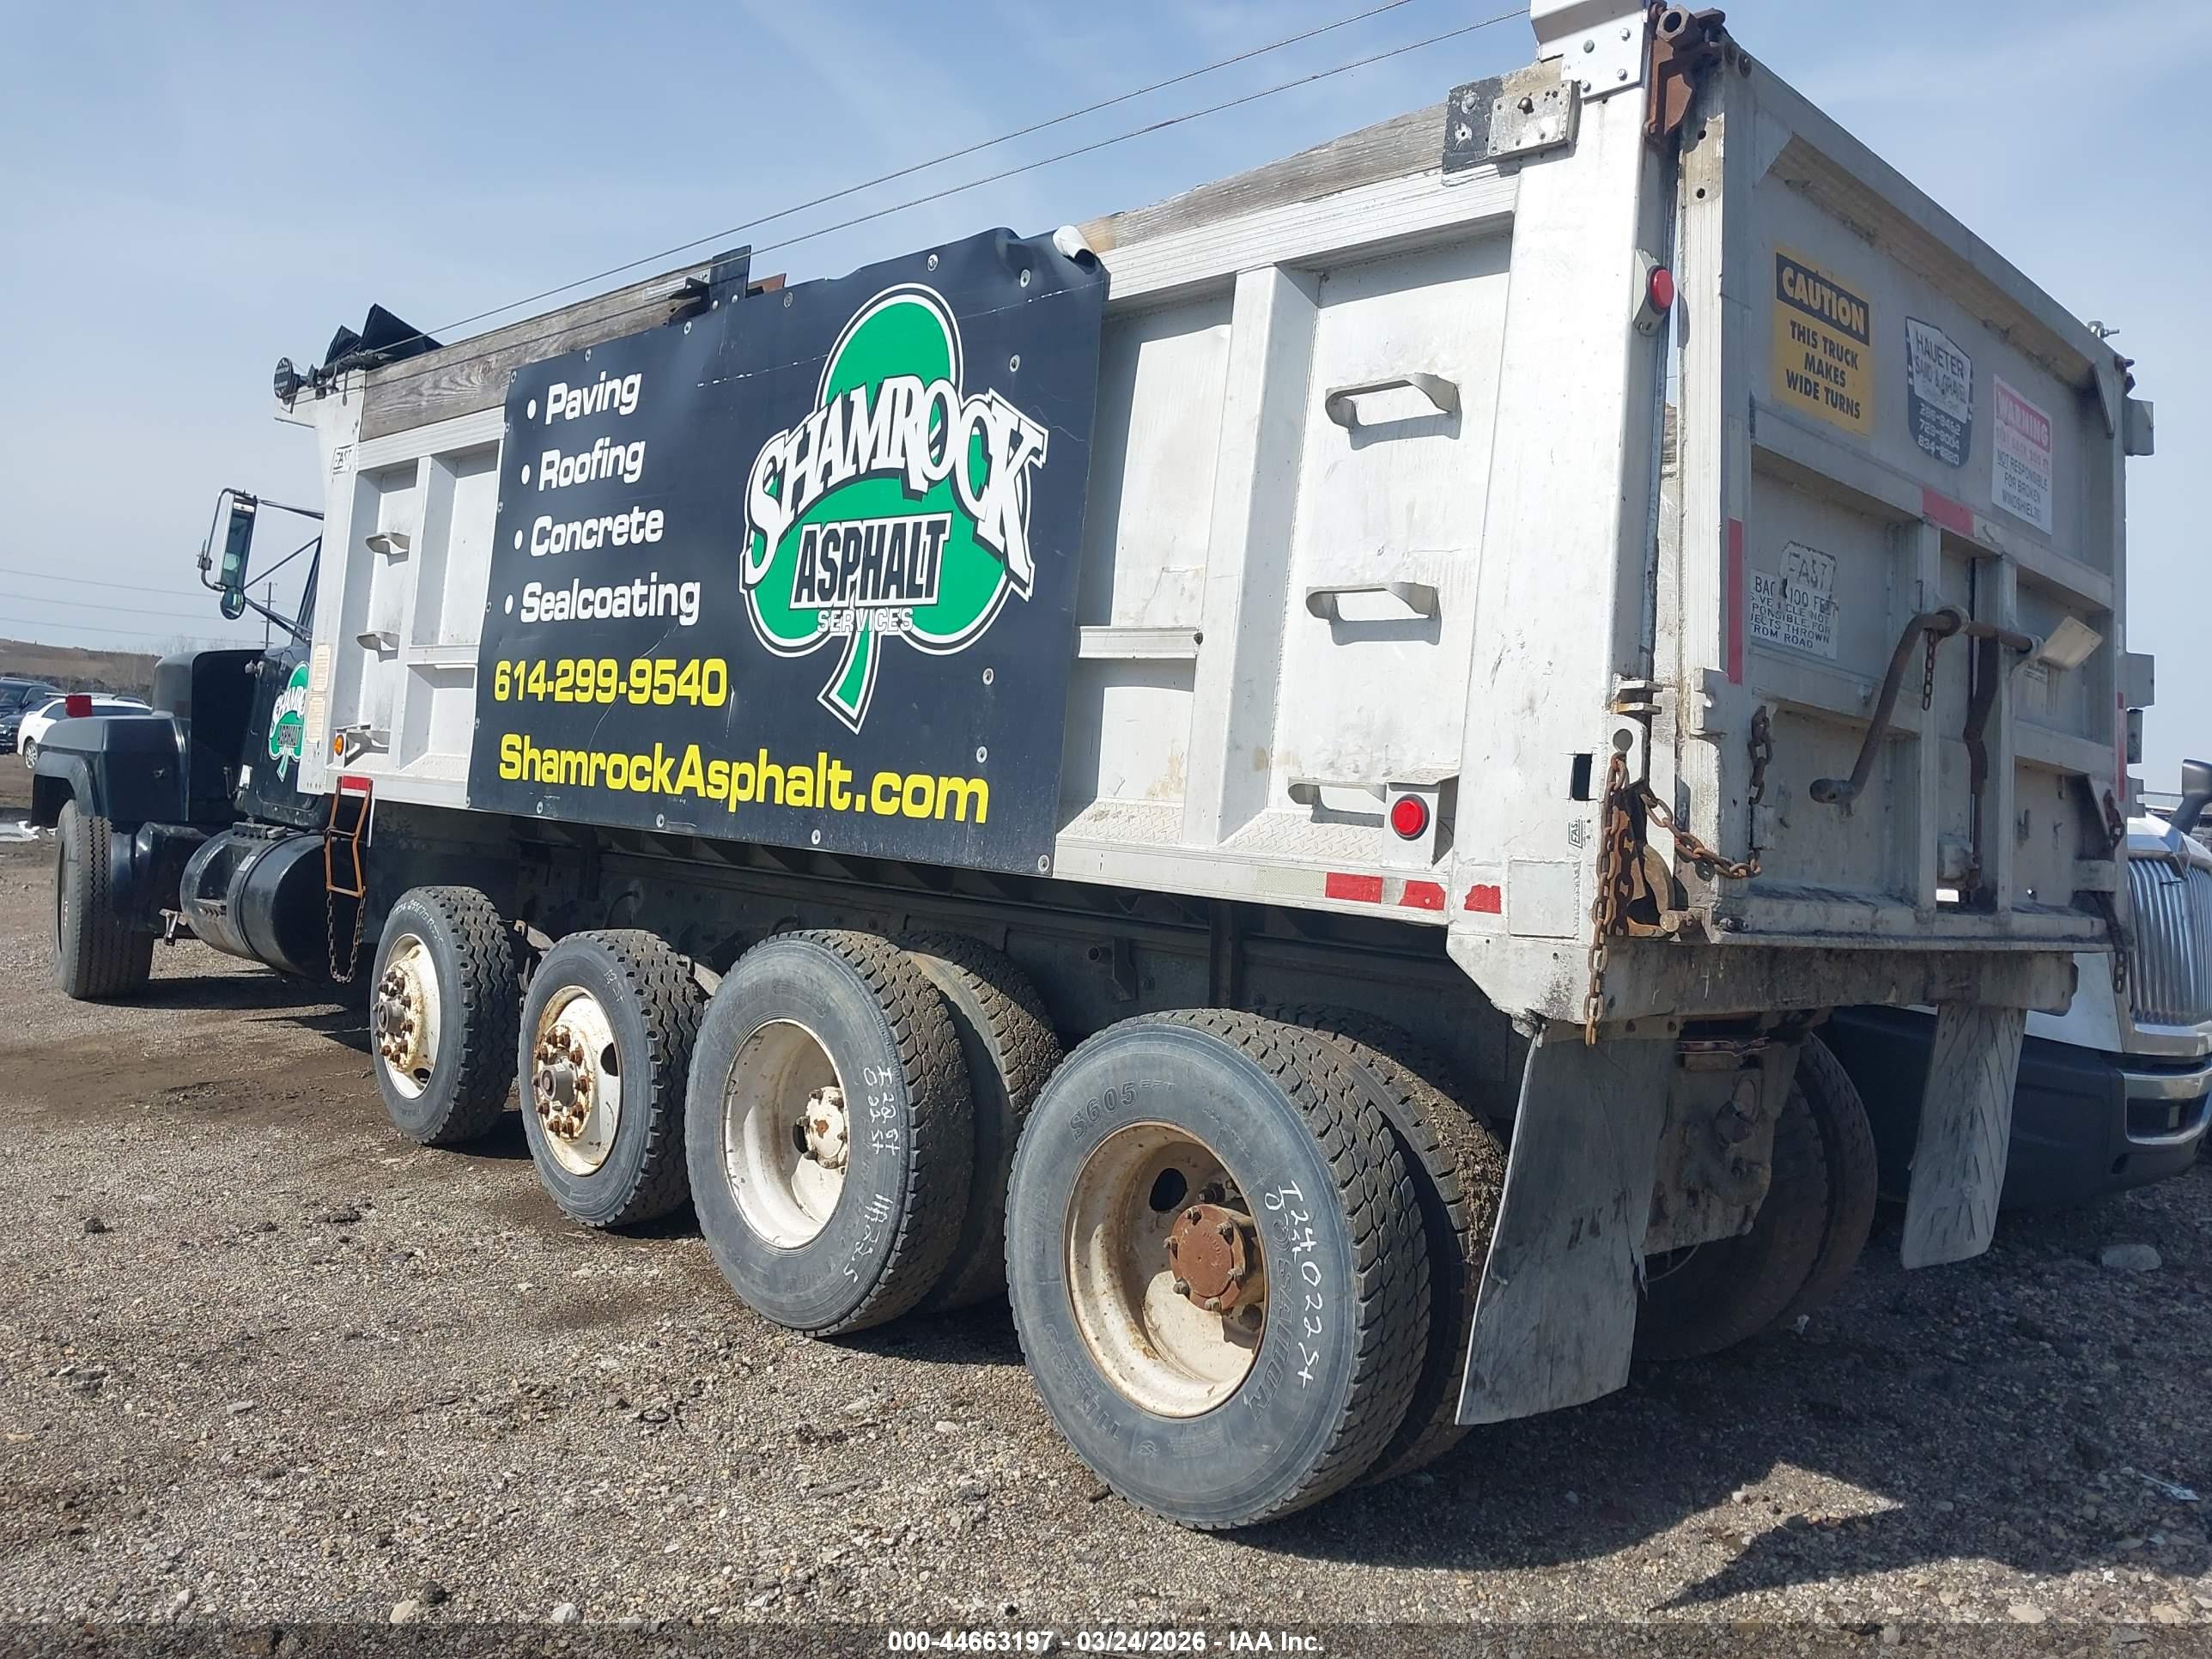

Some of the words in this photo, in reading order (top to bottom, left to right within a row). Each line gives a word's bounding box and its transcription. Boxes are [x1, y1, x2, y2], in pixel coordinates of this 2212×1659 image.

[1782, 266, 1865, 336] CAUTION
[1790, 319, 1818, 349] THIS
[1822, 336, 1859, 371] TRUCK
[1804, 352, 1845, 388] MAKES
[545, 371, 642, 425] Paving
[1786, 368, 1820, 401] WIDE
[1824, 386, 1861, 420] TURNS
[1996, 390, 2049, 447] WARNING
[538, 437, 646, 492] Roofing
[743, 374, 1046, 585] SHAMROCK
[530, 506, 665, 557] Concrete
[793, 519, 948, 603] ASPHALT
[520, 572, 702, 626] Sealcoating
[817, 607, 914, 633] SERVICES
[1751, 623, 1779, 639] ROM
[1784, 634, 1814, 649] ROAD
[1786, 623, 1830, 645] THROWN
[1812, 622, 1831, 635] FOR
[493, 658, 728, 708] 614-299-9540
[499, 733, 989, 824] ShamrockAsphalt.com
[1070, 1080, 1137, 1142] S605
